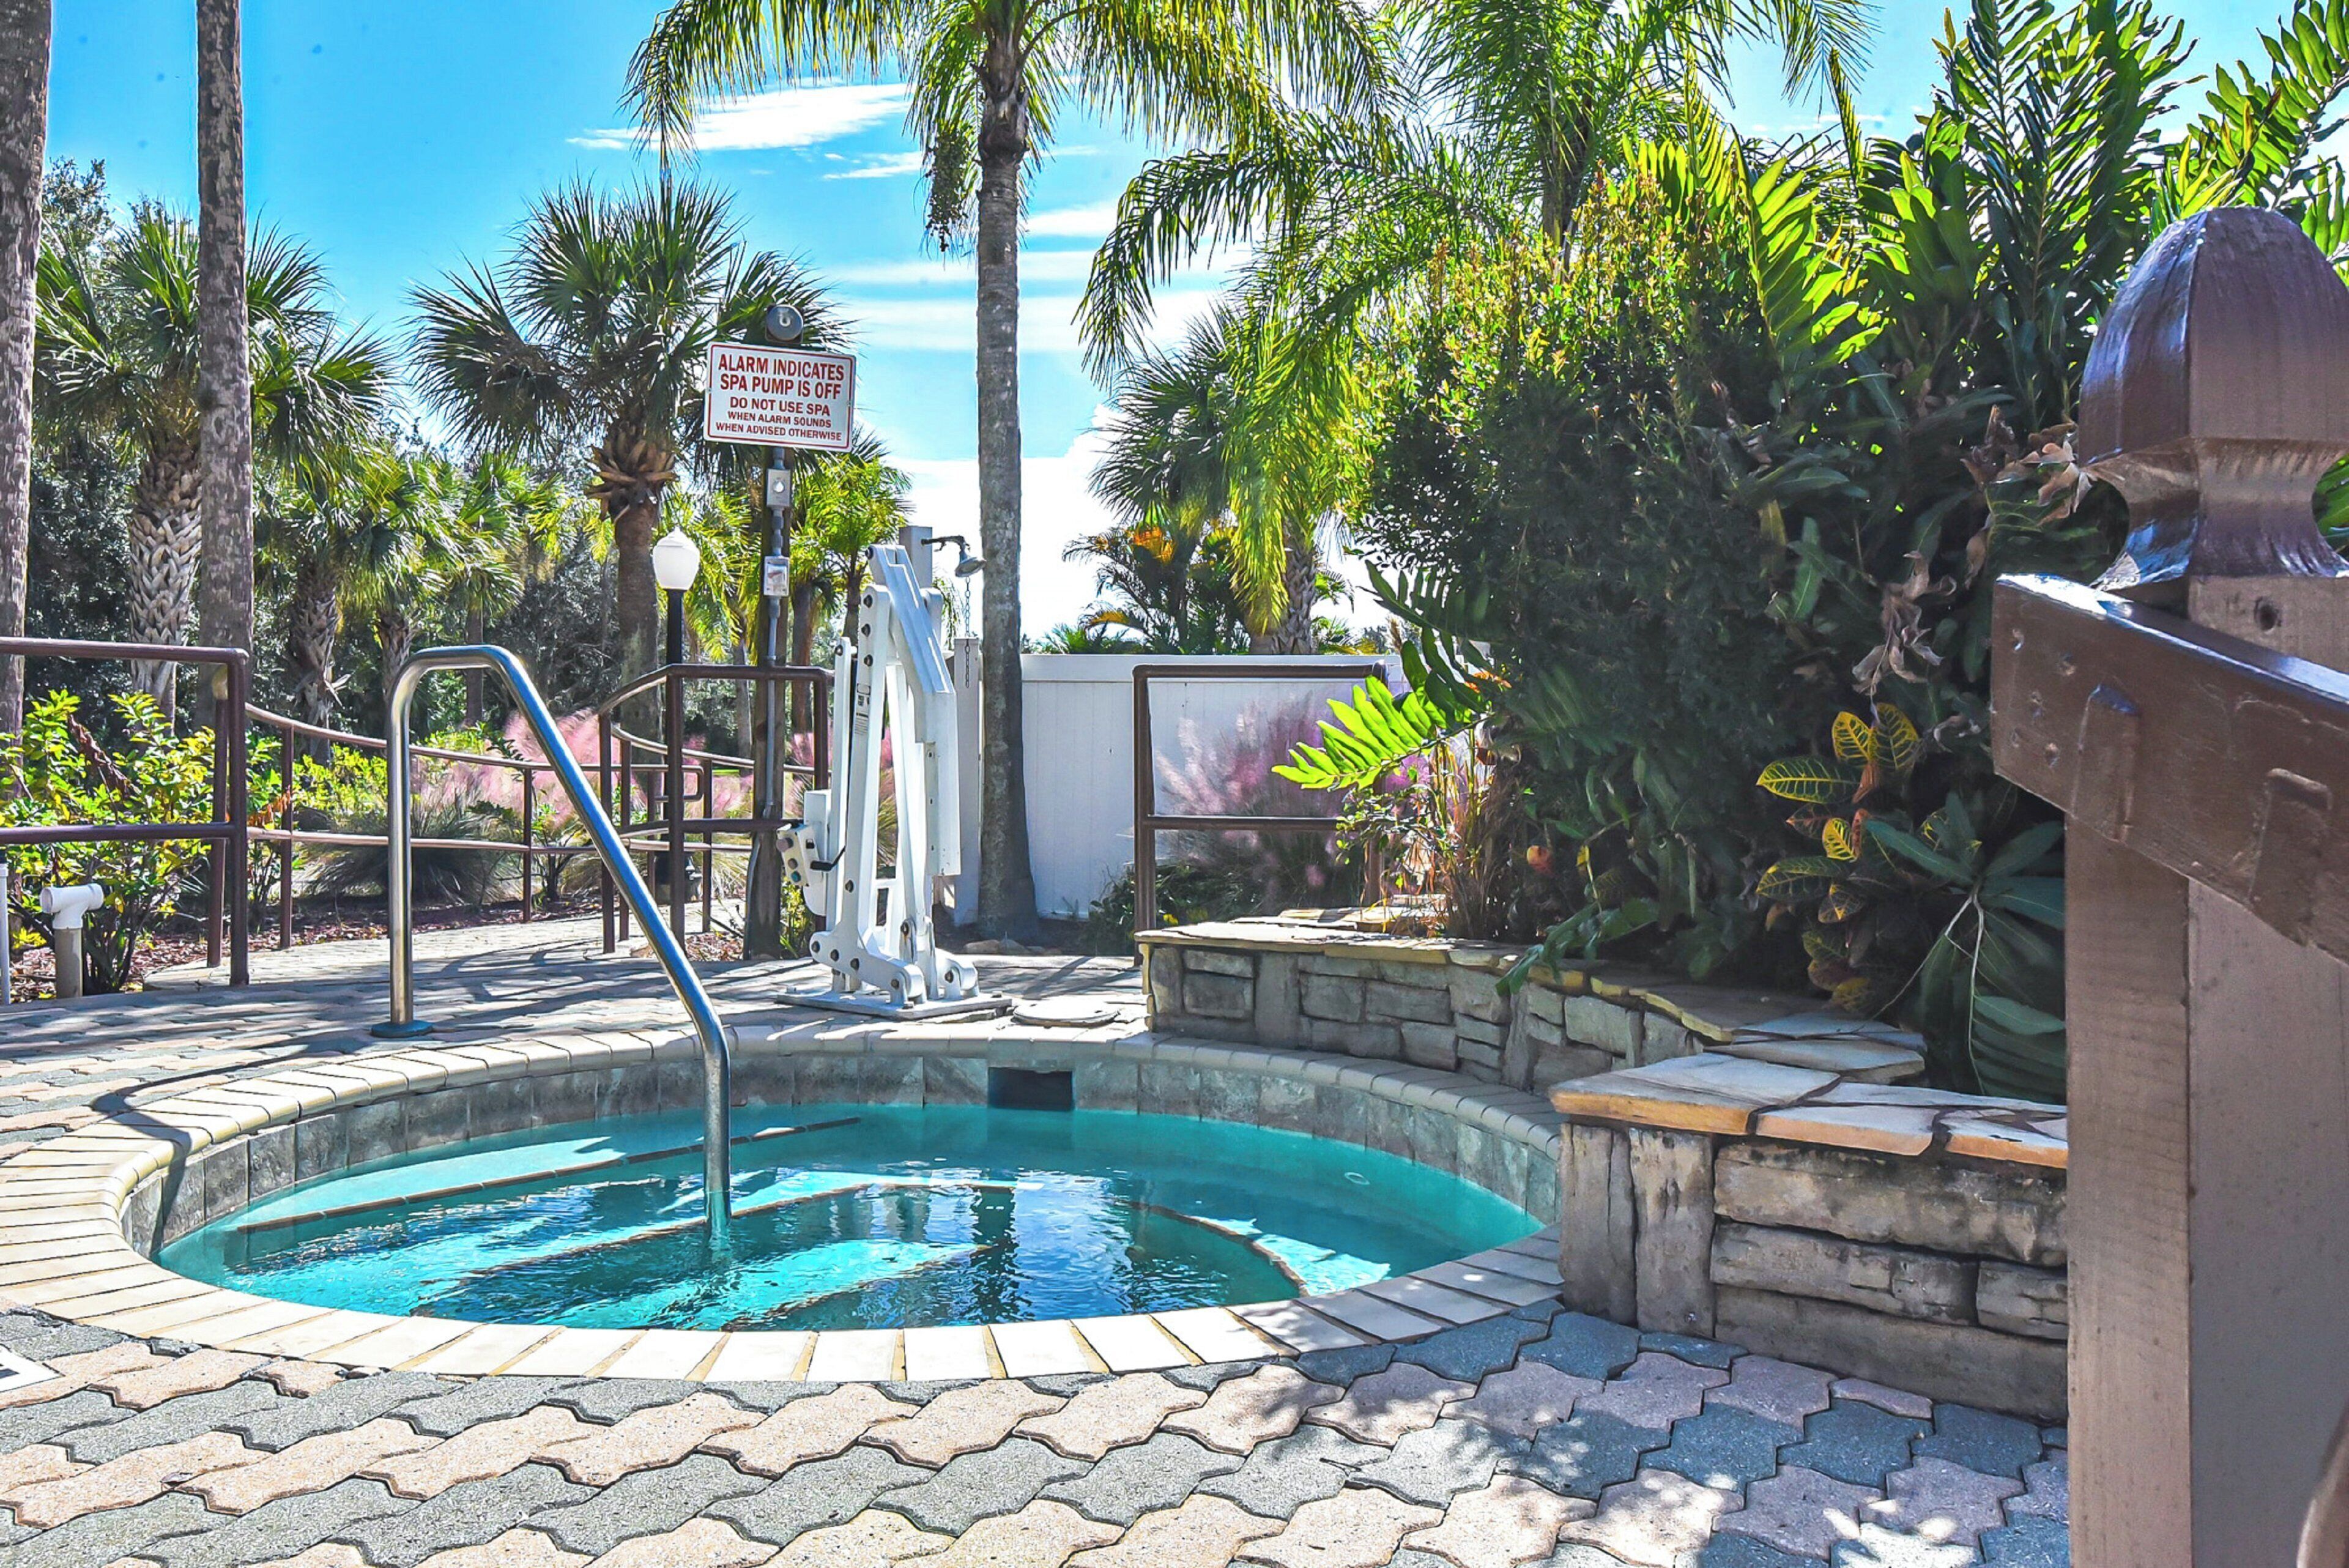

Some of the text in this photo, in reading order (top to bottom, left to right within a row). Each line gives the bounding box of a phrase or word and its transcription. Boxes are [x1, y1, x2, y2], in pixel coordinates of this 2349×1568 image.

[718, 354, 844, 381] ALARM INDICATES
[721, 374, 841, 399] SPA PUMP IS OFF
[730, 397, 830, 416] DO NOT USE SPA
[728, 411, 831, 428] WHEN ALARM SOUNDS
[716, 422, 842, 440] WHEN ADVISED OTHERWISE
